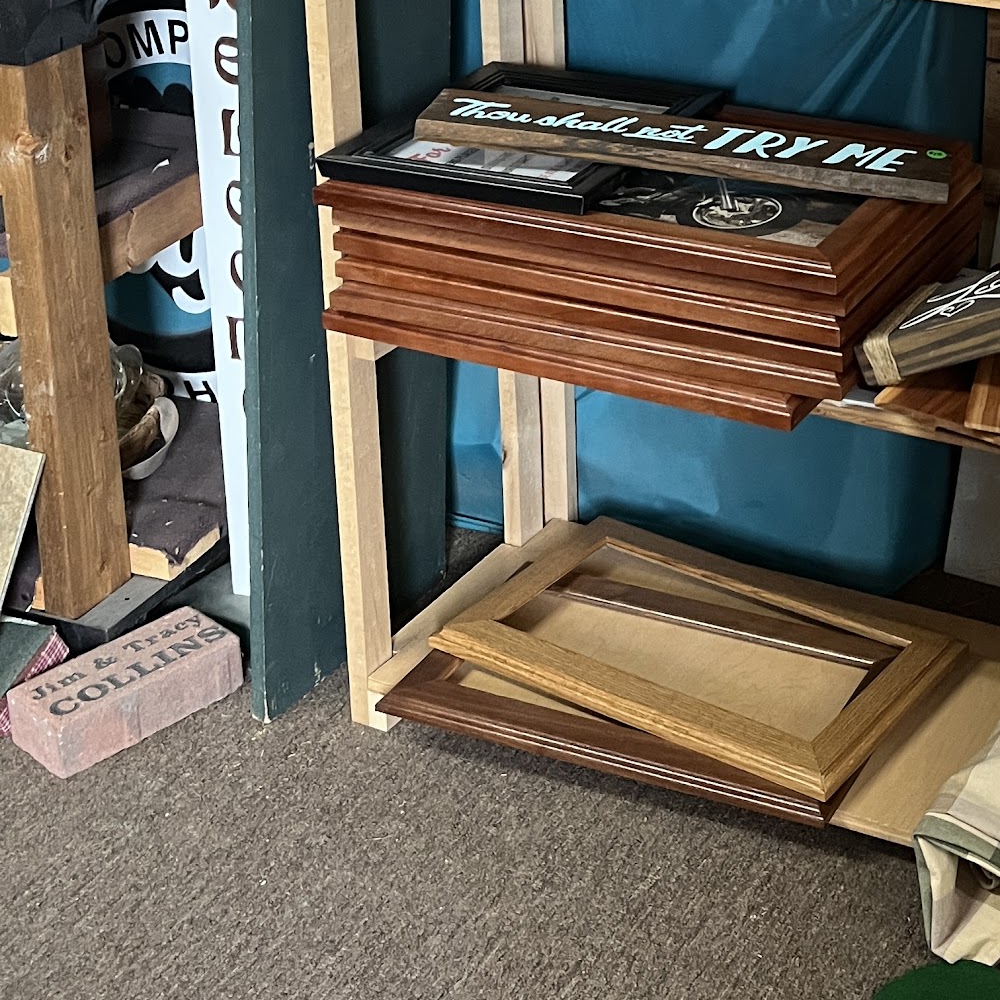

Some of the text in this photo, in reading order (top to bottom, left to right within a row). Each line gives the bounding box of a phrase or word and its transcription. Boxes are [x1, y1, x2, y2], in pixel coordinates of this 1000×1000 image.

[450, 97, 532, 123] Thou
[532, 112, 639, 133] shall
[624, 124, 708, 144] not
[703, 127, 829, 159] TRY
[821, 143, 918, 172] ME
[31, 614, 202, 700] Jim & Tracy
[49, 625, 228, 716] COLLINS
